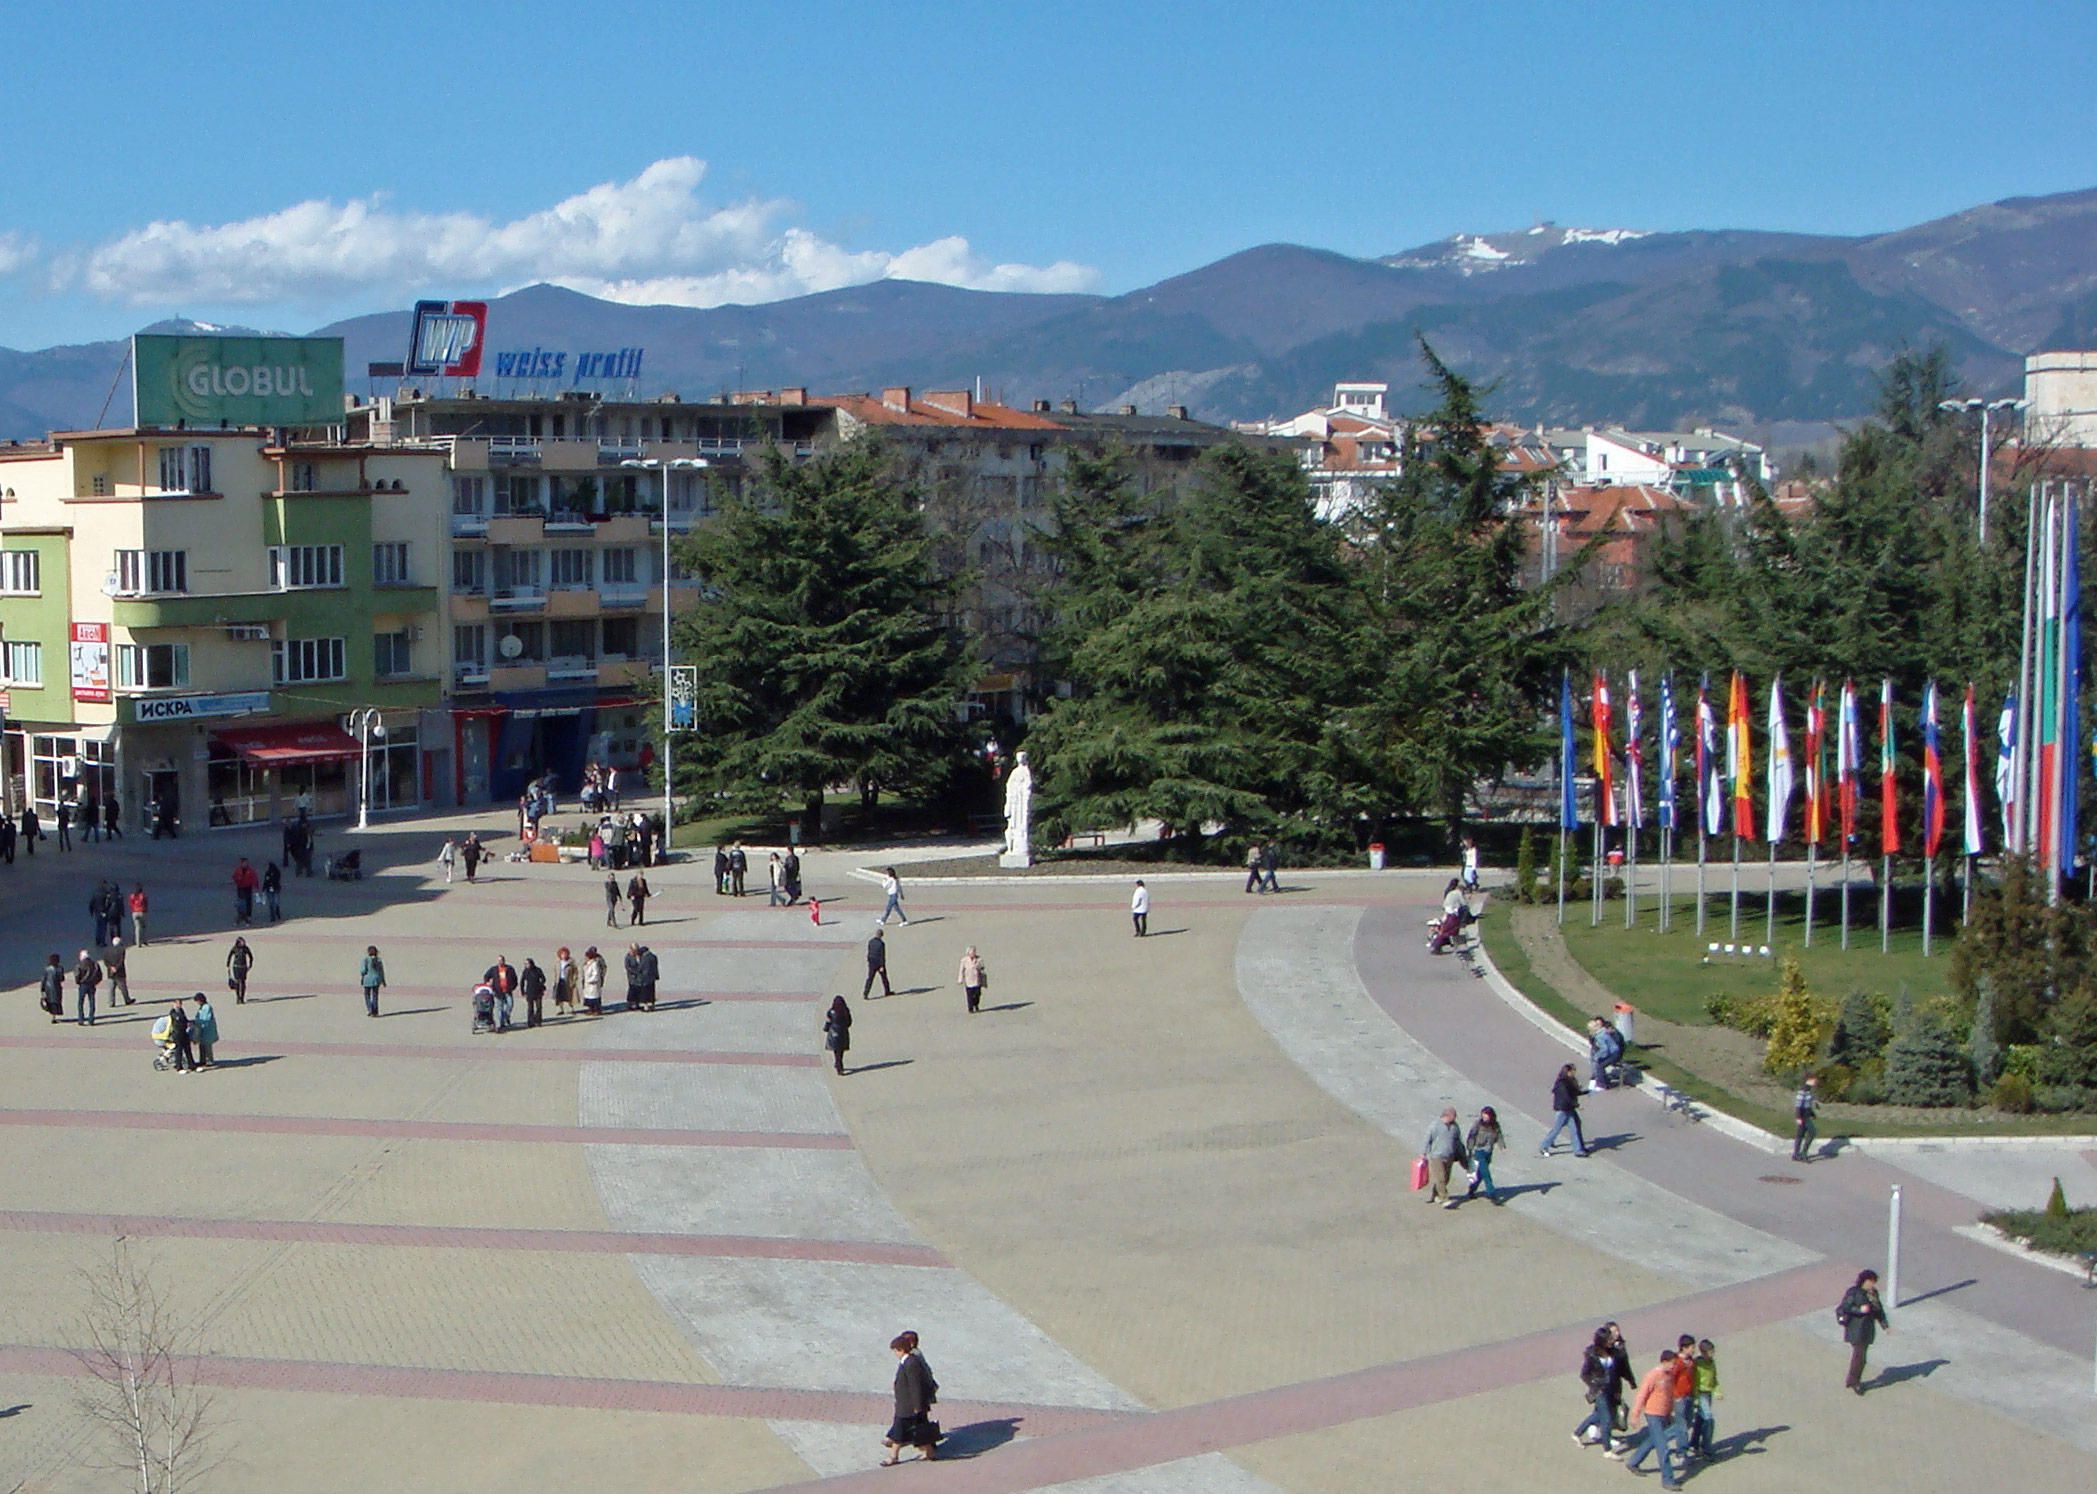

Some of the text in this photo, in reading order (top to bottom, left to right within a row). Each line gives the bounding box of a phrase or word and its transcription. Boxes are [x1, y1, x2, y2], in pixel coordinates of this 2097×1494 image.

[420, 315, 477, 364] WP
[495, 346, 568, 378] weiss
[188, 365, 314, 396] GLOBUL
[141, 700, 193, 718] ИСКРА
